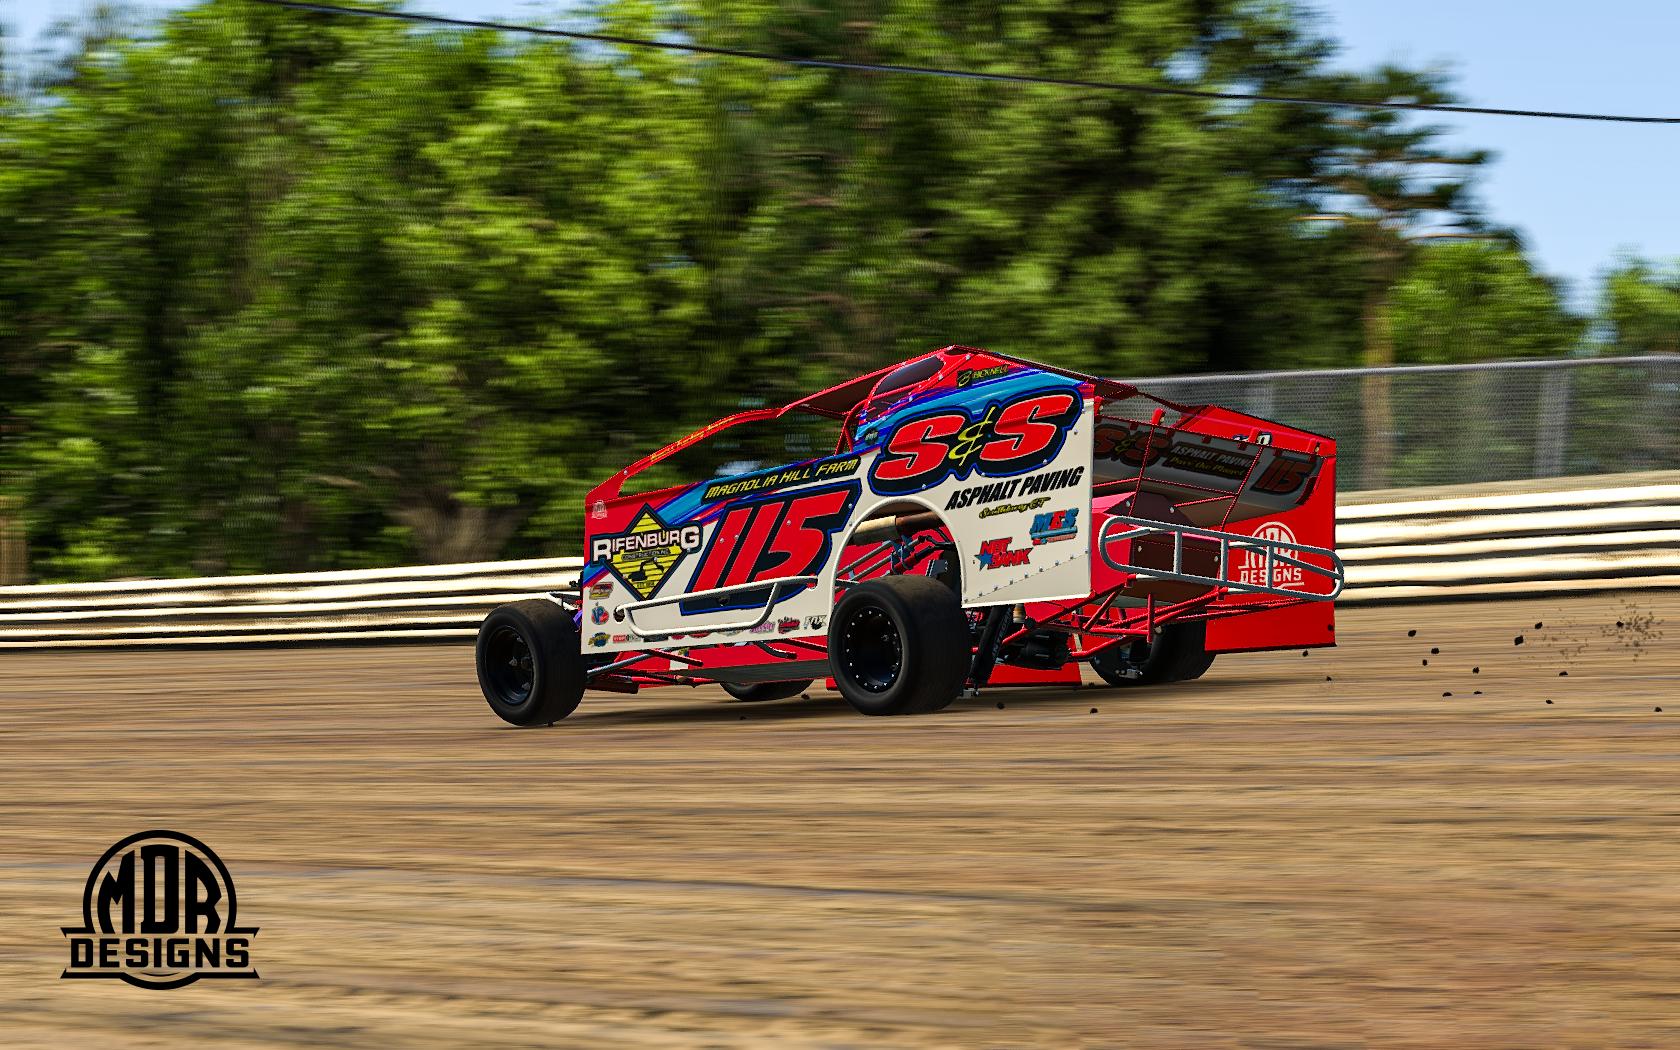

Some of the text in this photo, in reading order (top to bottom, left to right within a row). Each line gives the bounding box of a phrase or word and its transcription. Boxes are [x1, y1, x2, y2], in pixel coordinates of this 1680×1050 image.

[875, 394, 1074, 480] S&S
[1170, 445, 1217, 462] ASPHALT
[705, 458, 859, 499] MAGNOLIA HILL FARM
[944, 466, 1085, 511] ASPHALT PAVING
[1254, 458, 1316, 493] 115
[593, 526, 700, 562] RIFENBURG
[692, 490, 850, 593] 115
[980, 537, 1013, 554] NBT
[987, 547, 1033, 570] BANK
[1241, 568, 1302, 583] DESGNS
[803, 615, 827, 629] FOX
